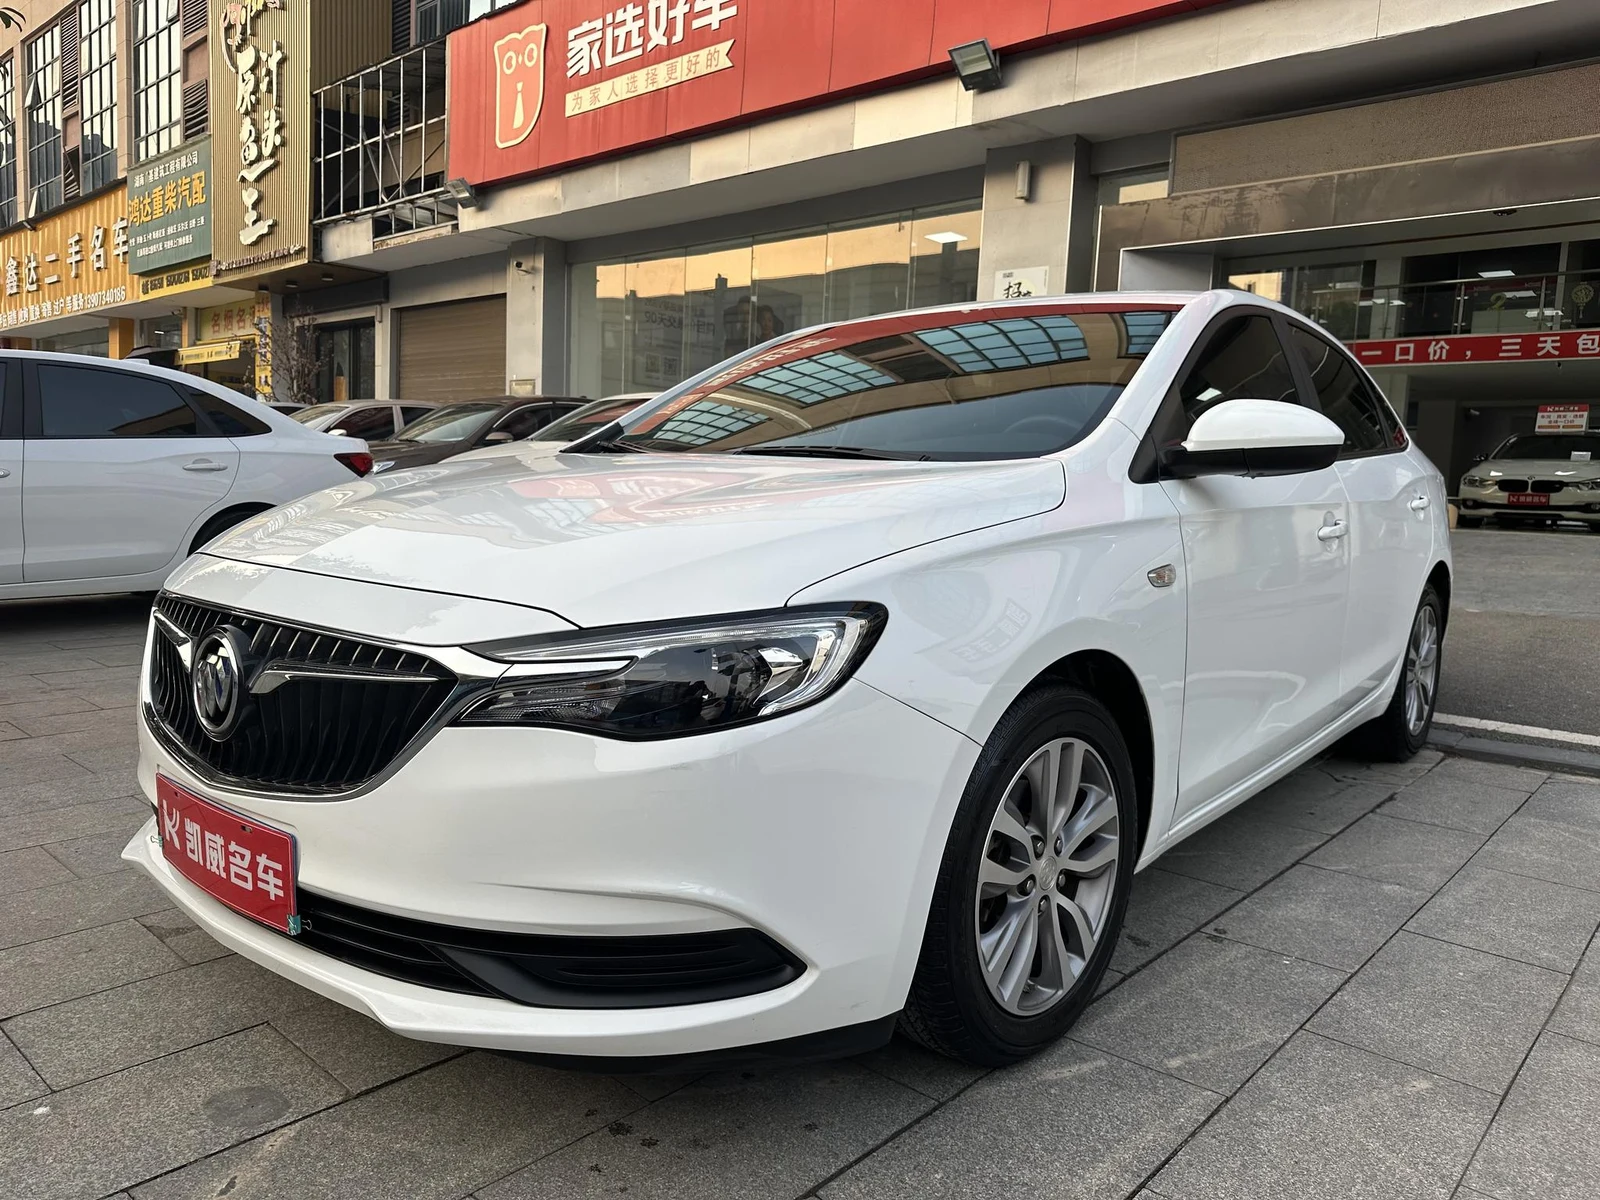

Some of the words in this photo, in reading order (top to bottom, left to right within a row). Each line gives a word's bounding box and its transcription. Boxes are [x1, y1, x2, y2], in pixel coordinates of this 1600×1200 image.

[566, 0, 738, 79] 家选好车
[571, 47, 721, 113] 为家人选择更好的
[128, 170, 207, 227] 鸿达重柴汽配
[134, 150, 198, 188] 湖南基建筑工程有限公司
[6, 217, 128, 296] 鑫达二手名车
[184, 817, 284, 901] 凯威名车
